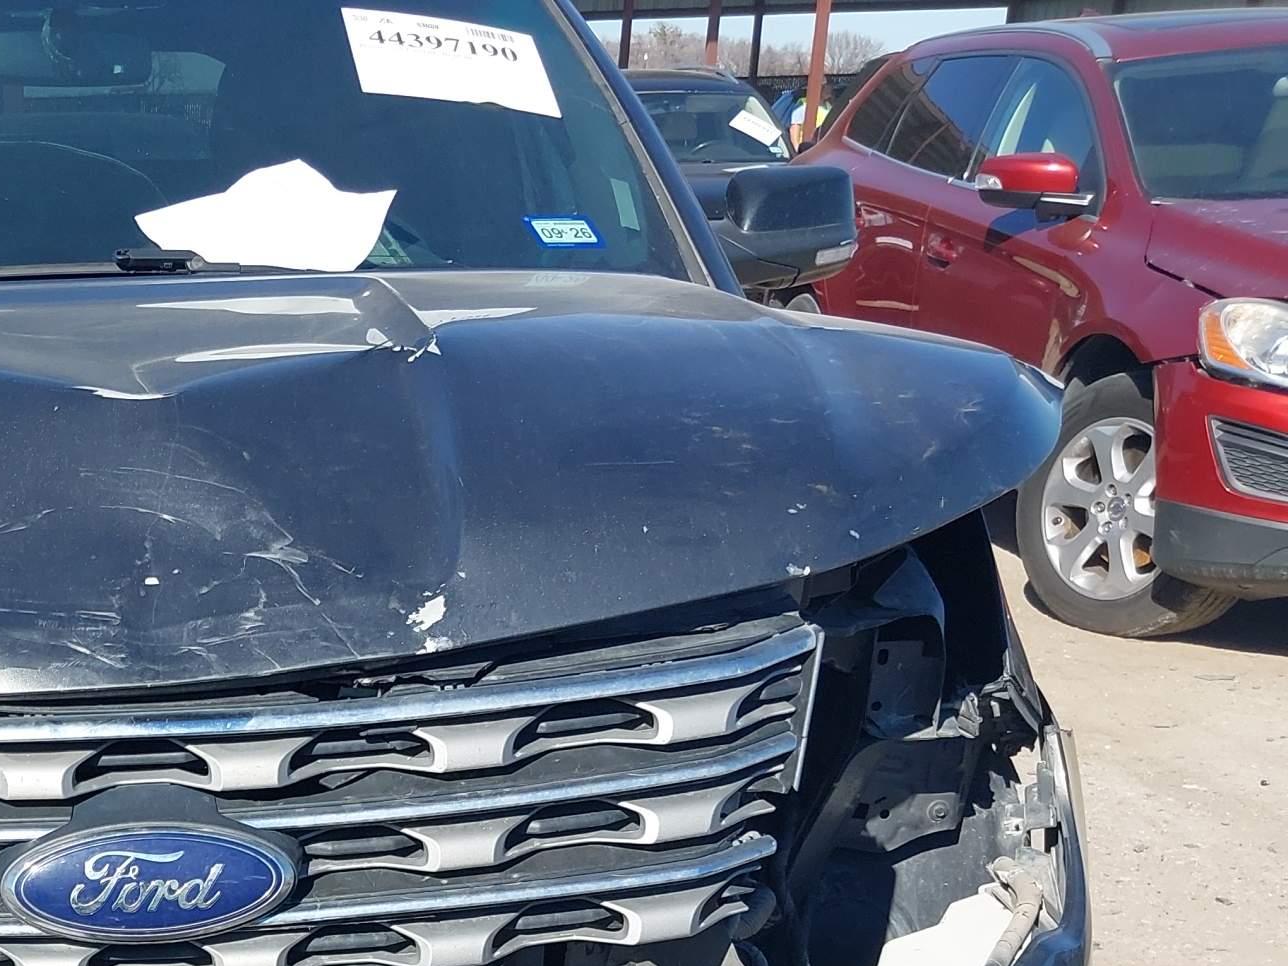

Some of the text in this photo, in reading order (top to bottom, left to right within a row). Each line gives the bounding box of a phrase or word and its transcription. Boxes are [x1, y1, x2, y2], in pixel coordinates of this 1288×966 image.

[368, 29, 518, 62] 44397190
[569, 227, 593, 239] 26
[69, 850, 226, 916] Ford
